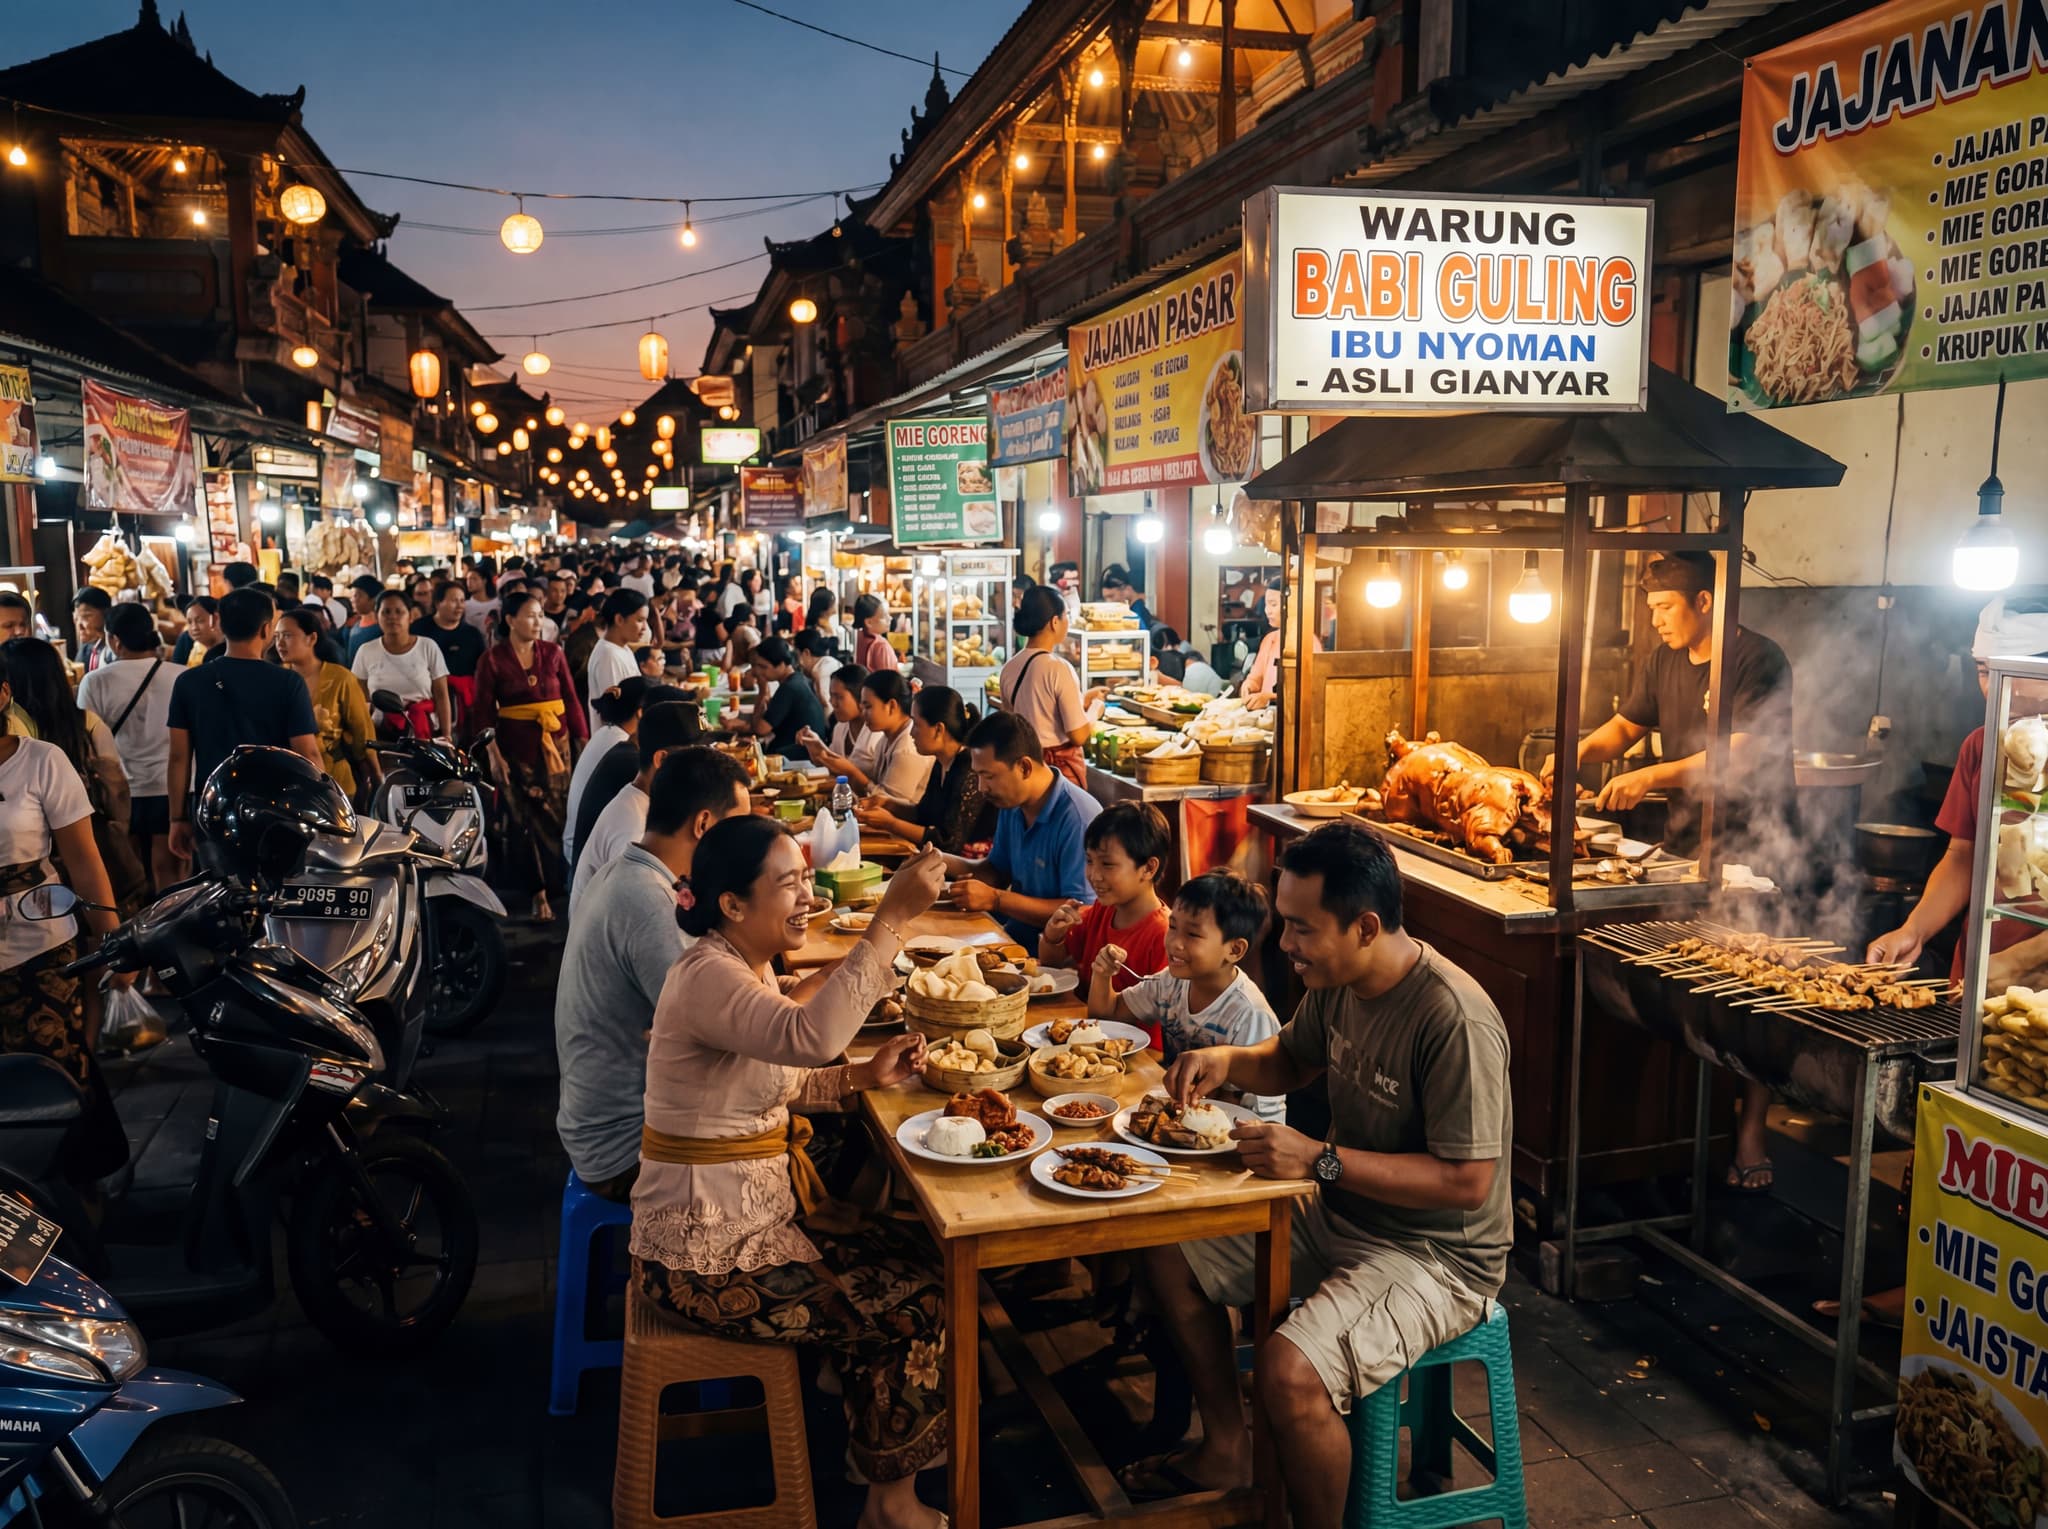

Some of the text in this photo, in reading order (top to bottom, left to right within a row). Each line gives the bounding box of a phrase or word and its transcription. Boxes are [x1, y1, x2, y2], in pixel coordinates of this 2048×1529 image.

[1947, 122, 2021, 168] JAJAN
[1944, 158, 2048, 207] MIE GOR
[1359, 205, 1576, 246] WARUNG
[1941, 211, 1984, 246] MIE
[1941, 252, 1982, 285] MIE
[1294, 249, 1636, 326] BABI GULING
[1938, 286, 2008, 324] JAJAN
[1083, 271, 1235, 371] JAJANAN PASAR
[1330, 330, 1596, 362] IBU NYOMAN
[1937, 325, 2028, 362] KRUPUK
[1321, 368, 1413, 395] ASLI
[1430, 369, 1610, 396] GIANYAR
[896, 427, 924, 447] MIE
[348, 890, 369, 904] 90
[1934, 1220, 1998, 1293] MIE
